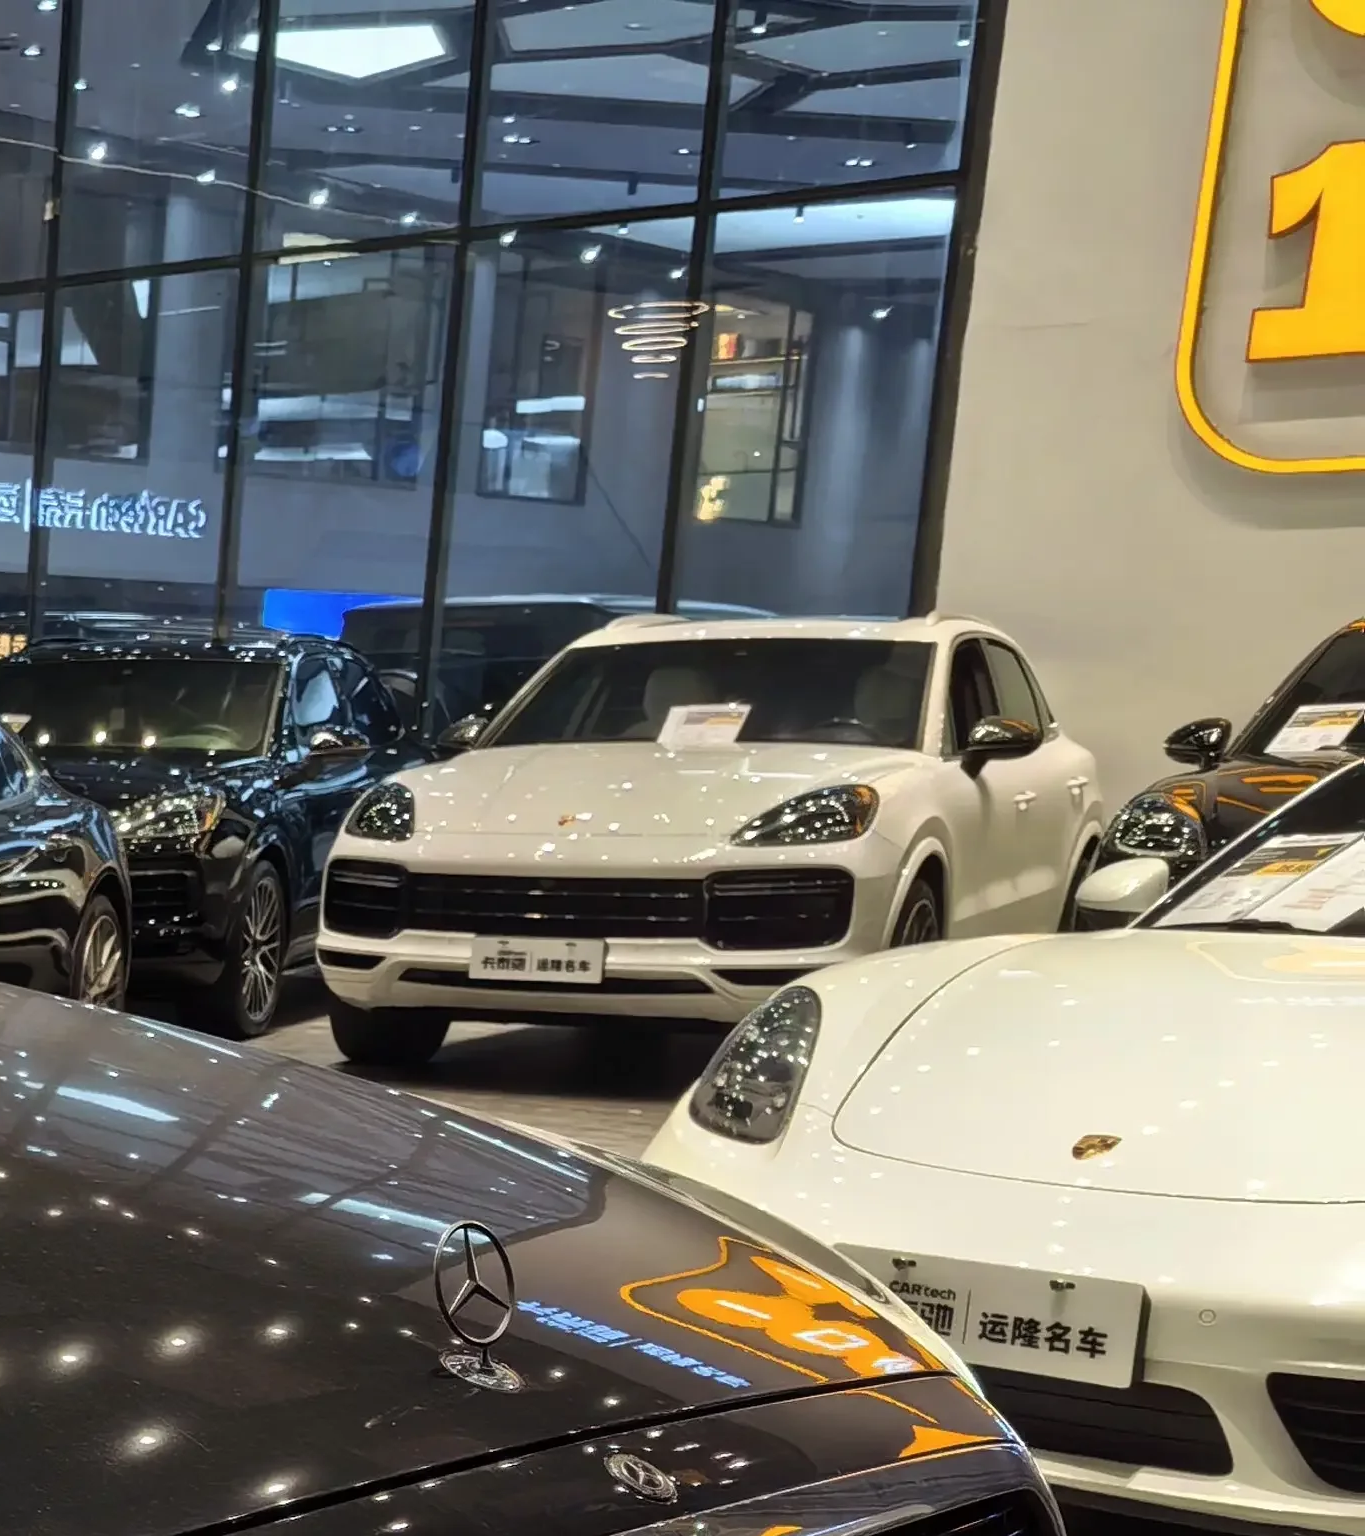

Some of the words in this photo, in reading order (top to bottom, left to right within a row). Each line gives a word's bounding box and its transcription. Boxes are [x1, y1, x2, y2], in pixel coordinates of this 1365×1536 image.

[889, 1280, 957, 1301] CARtech
[977, 1311, 1108, 1359] 运隆名车
